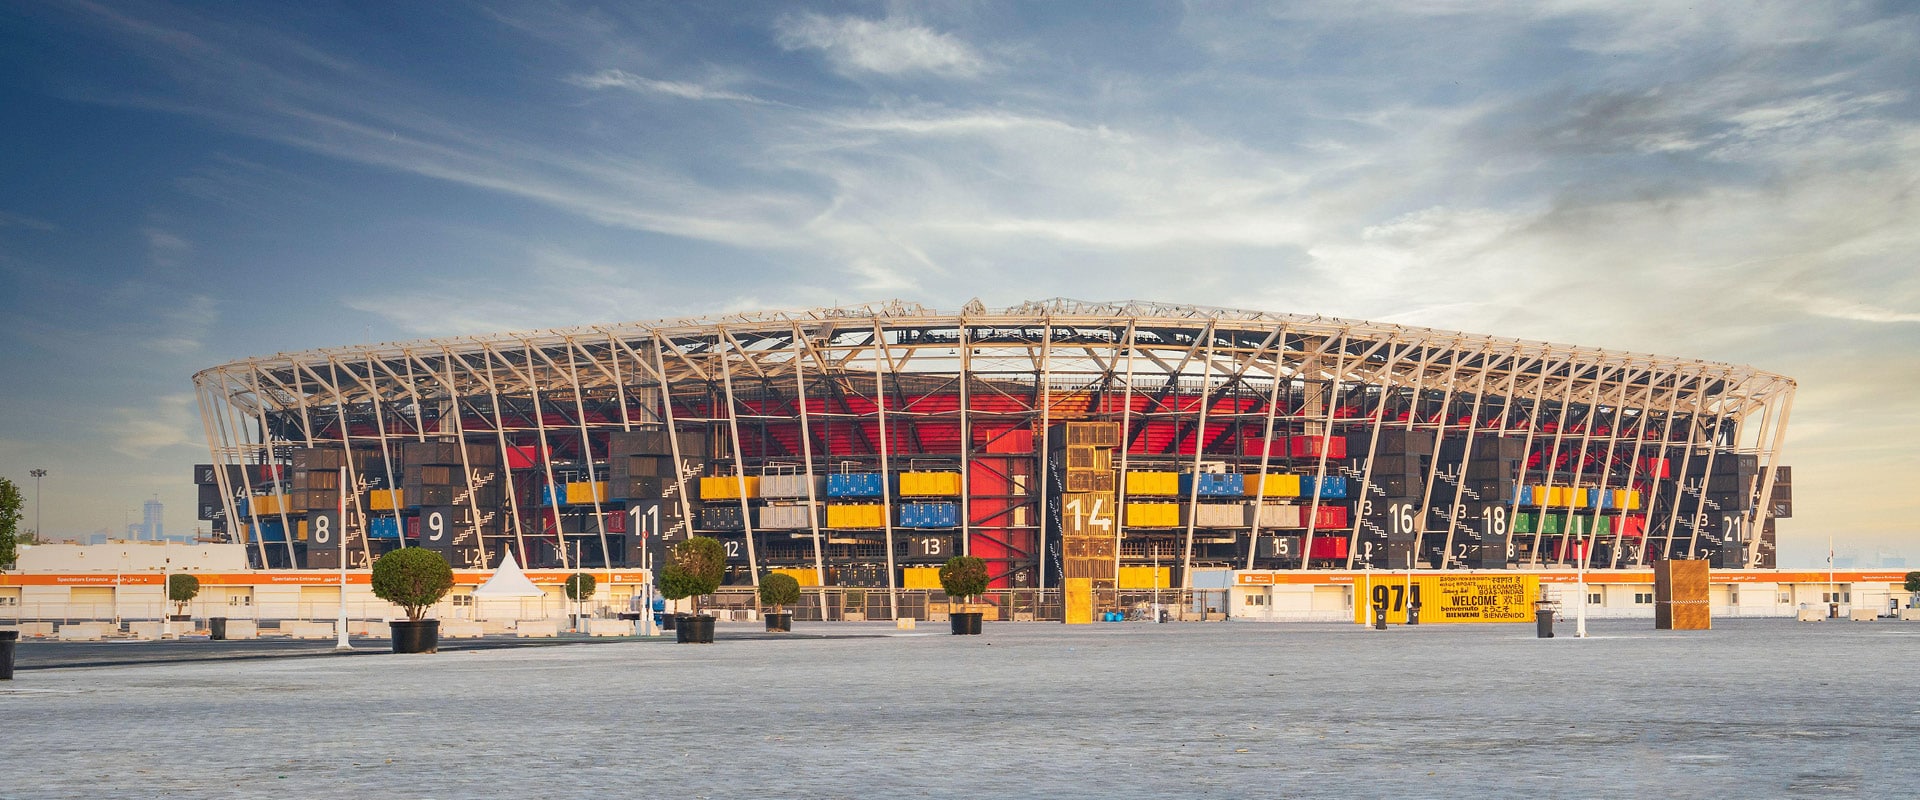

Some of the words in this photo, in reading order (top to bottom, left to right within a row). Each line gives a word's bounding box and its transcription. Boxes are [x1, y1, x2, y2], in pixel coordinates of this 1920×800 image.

[629, 504, 658, 536] 11
[1066, 499, 1112, 531] 14
[1388, 503, 1413, 534] 16
[1482, 506, 1506, 535] 18
[315, 515, 329, 543] 8
[428, 512, 444, 541] 9
[1724, 515, 1741, 542] 21
[724, 541, 739, 557] 12
[921, 538, 940, 555] 13
[1273, 538, 1288, 555] 15
[350, 551, 367, 566] L2
[464, 549, 482, 564] L2
[1477, 583, 1524, 591] WILLKOMMEN
[1372, 584, 1422, 612] 974
[1451, 595, 1498, 606] WELCOME
[1503, 595, 1524, 605] 欢迎
[1482, 605, 1510, 613] ようこそ
